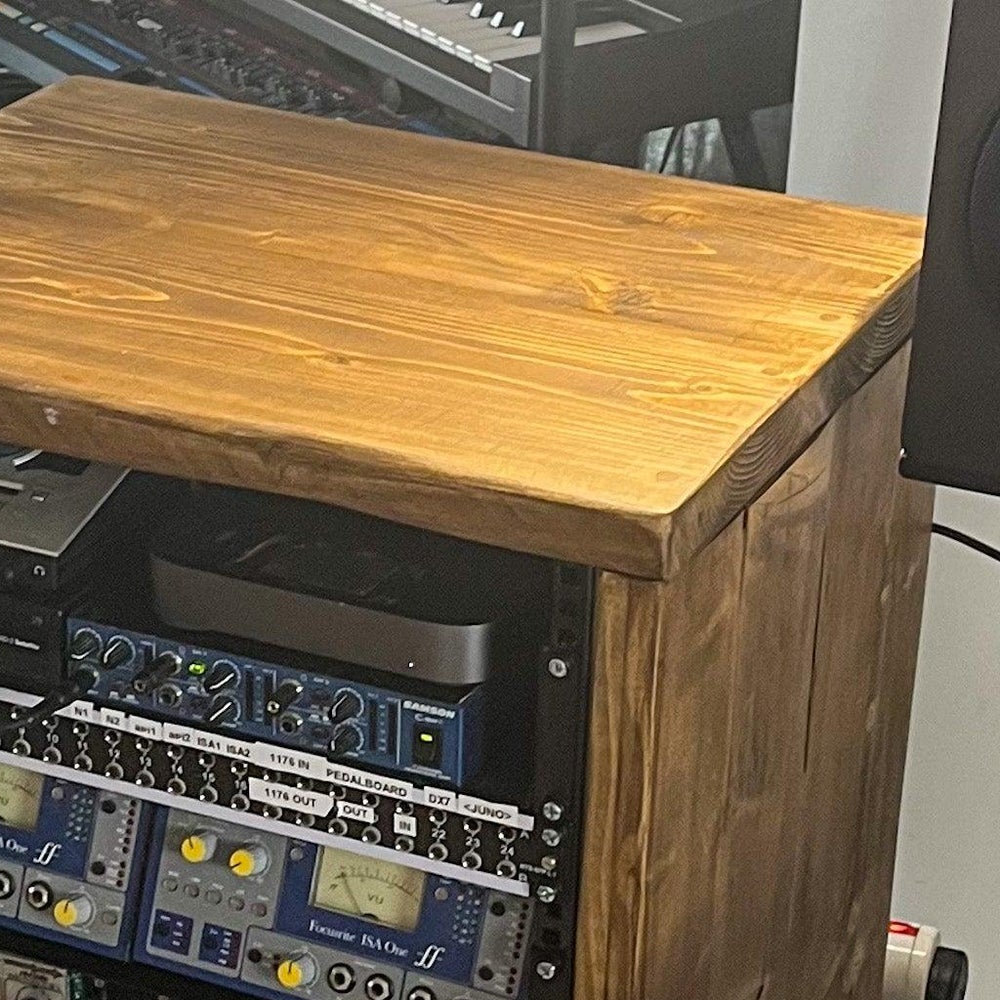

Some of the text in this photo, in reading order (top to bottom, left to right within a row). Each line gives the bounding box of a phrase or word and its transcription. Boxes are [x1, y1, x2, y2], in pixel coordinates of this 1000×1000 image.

[403, 700, 456, 720] SAMSON
[197, 736, 251, 758] ISA1 ISA2
[269, 753, 310, 771] 1176 IN
[326, 768, 407, 797] PEDALBOARD
[264, 787, 317, 808] 1176 OUT
[428, 793, 451, 807] DX7
[343, 805, 368, 818] OUT
[431, 827, 447, 841] 22
[6, 838, 29, 854] One
[500, 845, 515, 857] 24
[367, 893, 384, 905] VU
[308, 919, 409, 957] Focusrite ISA One
